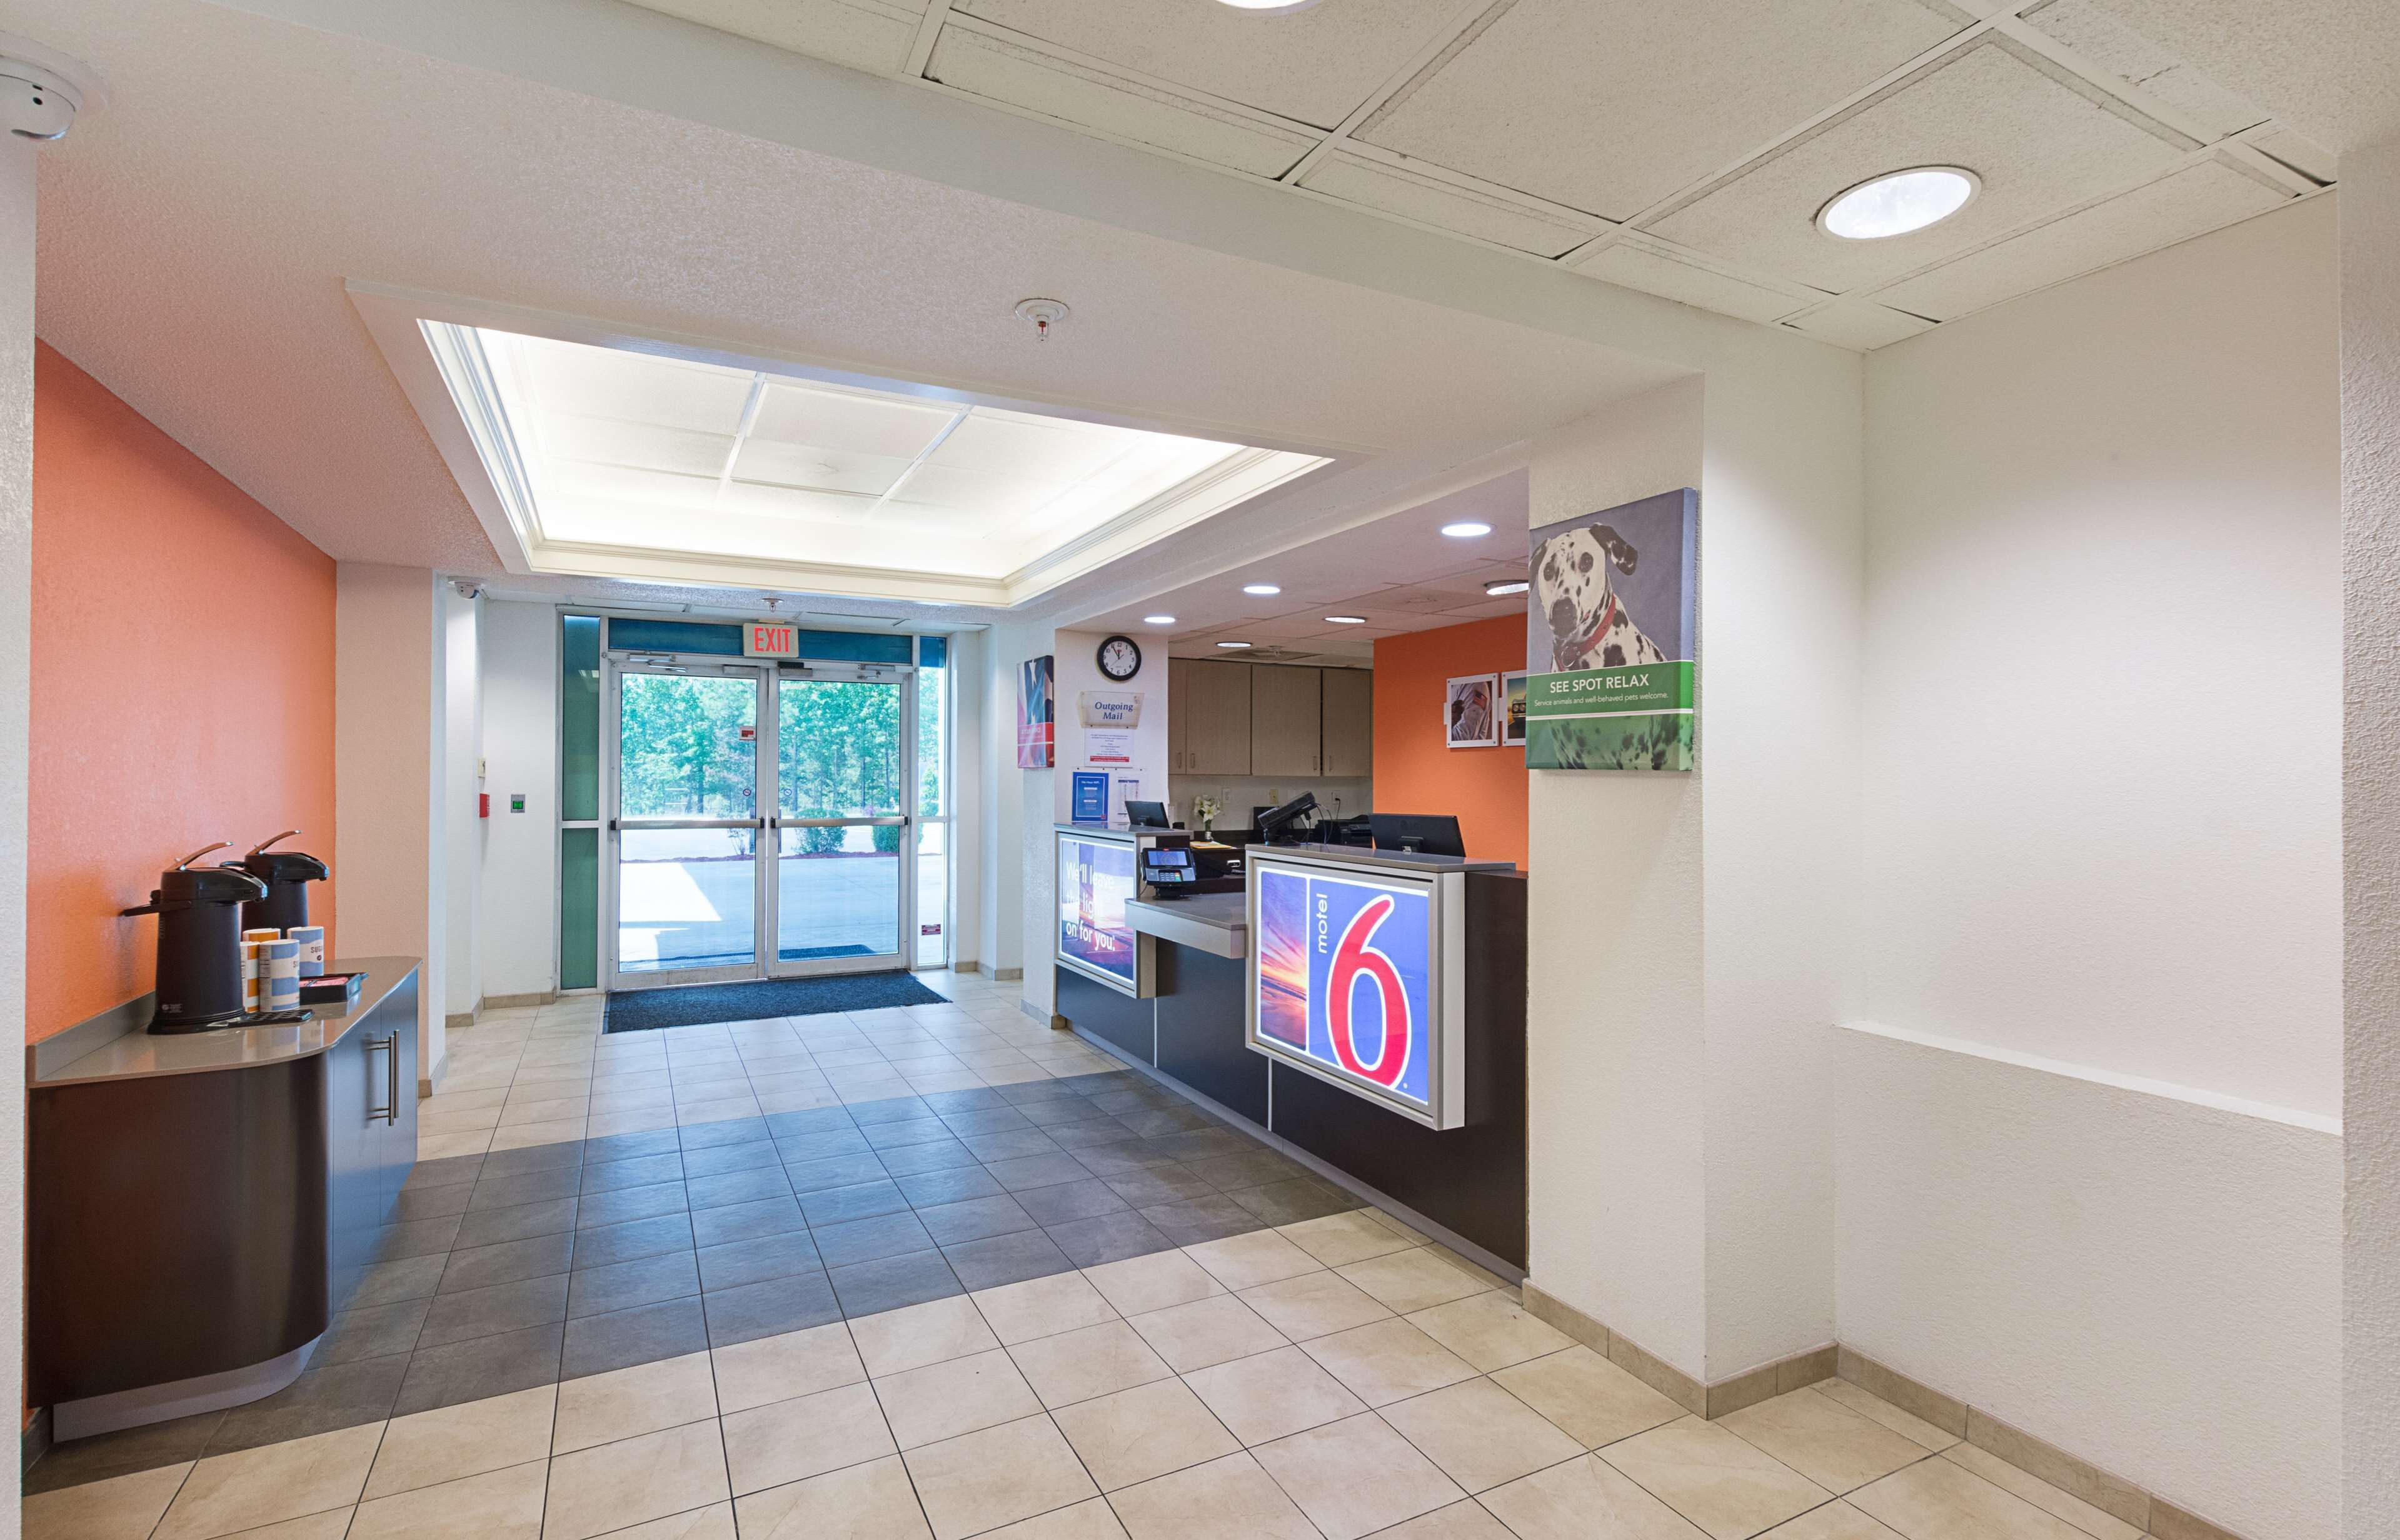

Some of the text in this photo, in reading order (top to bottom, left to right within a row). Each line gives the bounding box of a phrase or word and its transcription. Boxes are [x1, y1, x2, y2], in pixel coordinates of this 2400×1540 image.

[754, 627, 791, 652] EXIT
[1550, 674, 1649, 693] SEE SPOT RELAX
[1095, 702, 1133, 712] Outgoing
[1585, 694, 1624, 703] well-behaved
[1625, 694, 1638, 703] pets
[1066, 862, 1114, 888] We'll leave
[1066, 922, 1077, 937] on
[1080, 920, 1093, 942] for
[1316, 893, 1328, 954] motel
[1326, 894, 1412, 1089] 6
